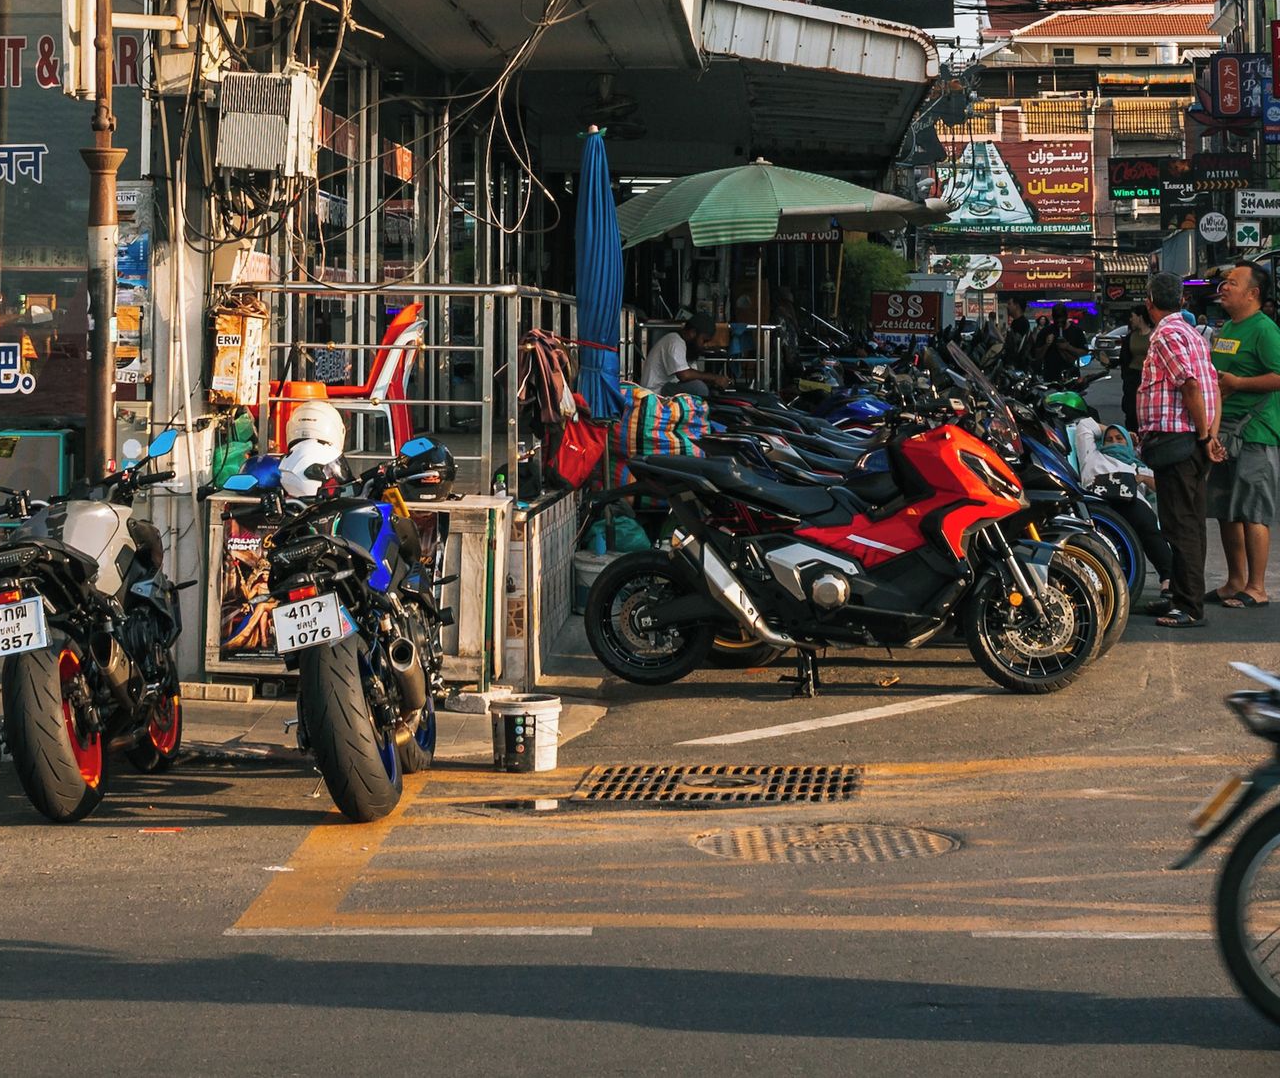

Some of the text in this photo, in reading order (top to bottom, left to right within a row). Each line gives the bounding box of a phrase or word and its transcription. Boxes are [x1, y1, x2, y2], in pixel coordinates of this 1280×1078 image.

[36, 34, 61, 89] &
[1206, 170, 1239, 178] PATTAYA
[1114, 189, 1135, 197] Wine
[217, 335, 241, 345] ERW
[288, 626, 331, 647] 1076
